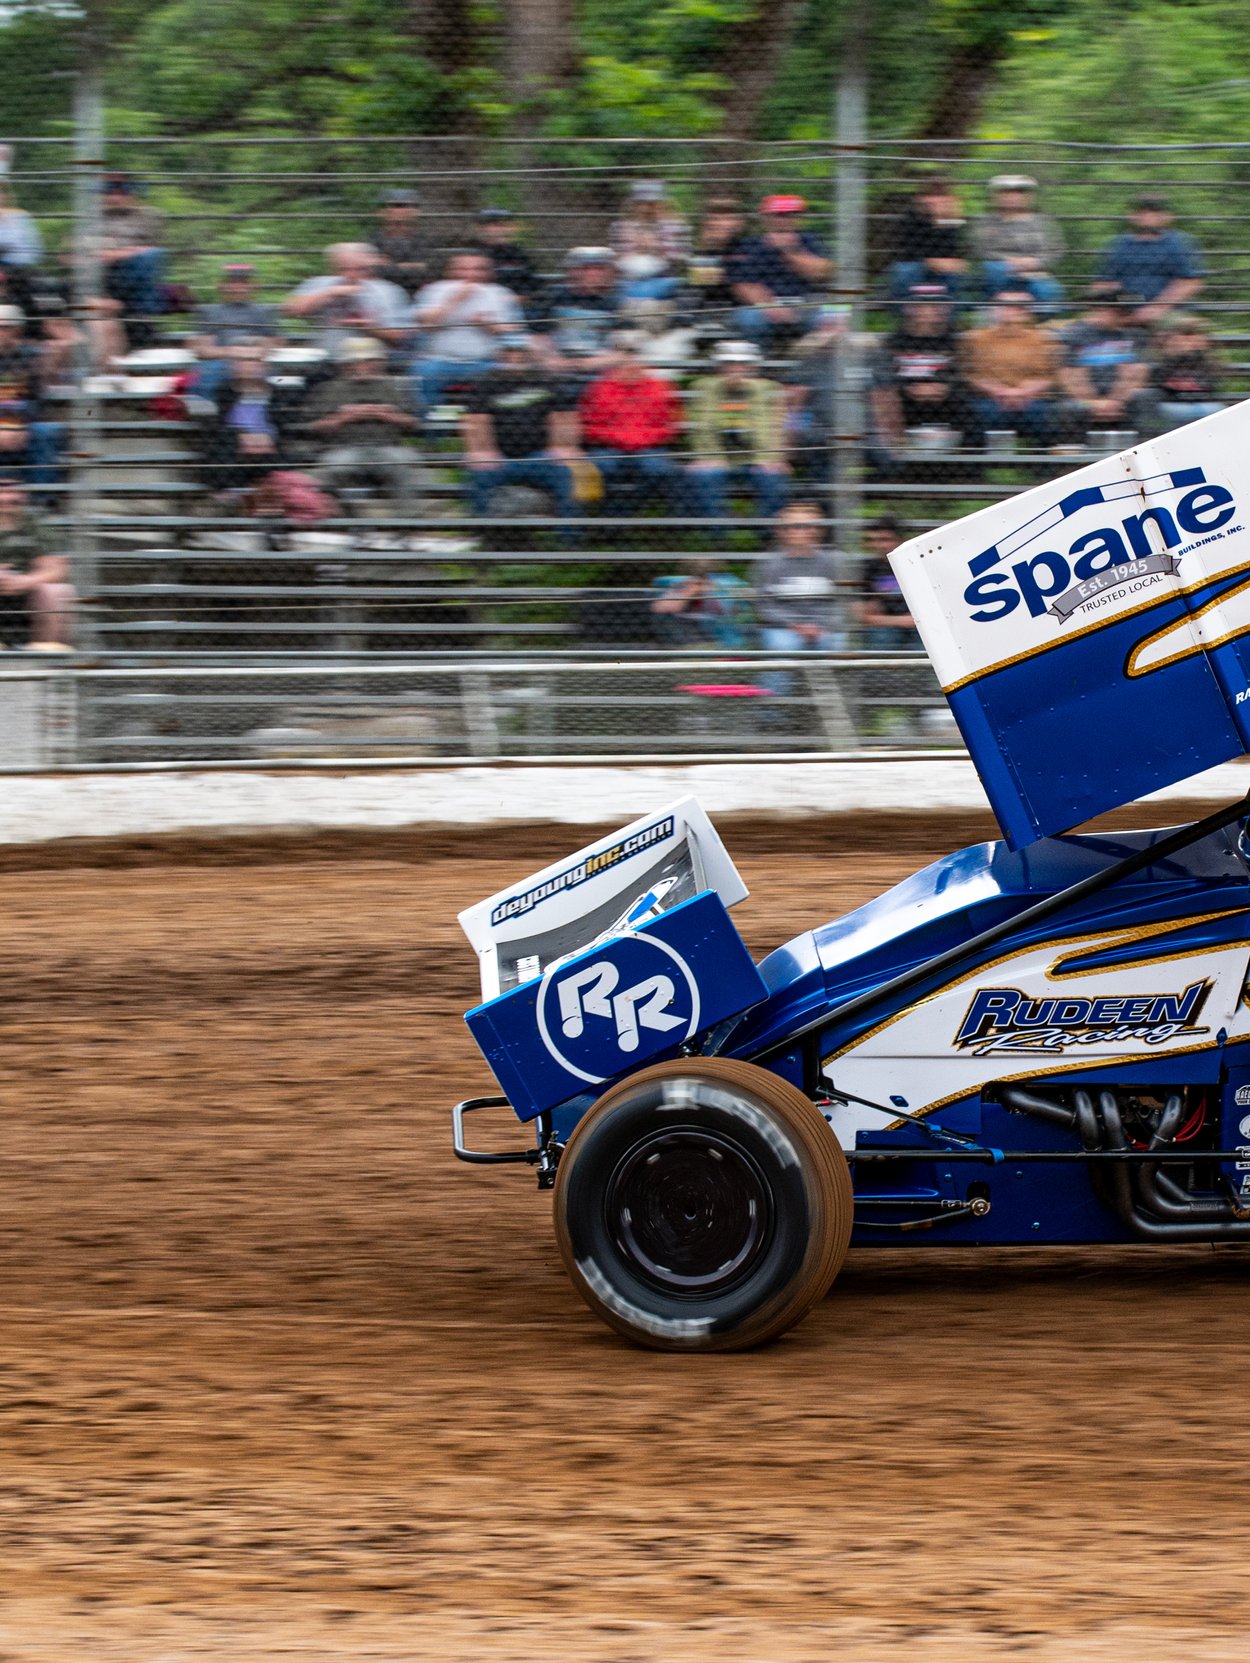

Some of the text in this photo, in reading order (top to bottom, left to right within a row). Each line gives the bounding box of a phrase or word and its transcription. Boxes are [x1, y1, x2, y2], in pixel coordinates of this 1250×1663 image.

[964, 484, 1237, 623] spane
[1178, 525, 1246, 557] BUILDINGS, INC.
[1077, 559, 1149, 599] Est. 1945
[1080, 574, 1164, 614] TRUSTED LOCAL
[492, 818, 672, 925] deyounginc.com
[958, 980, 1207, 1042] RUDEEN
[967, 1022, 1209, 1056] Racing
